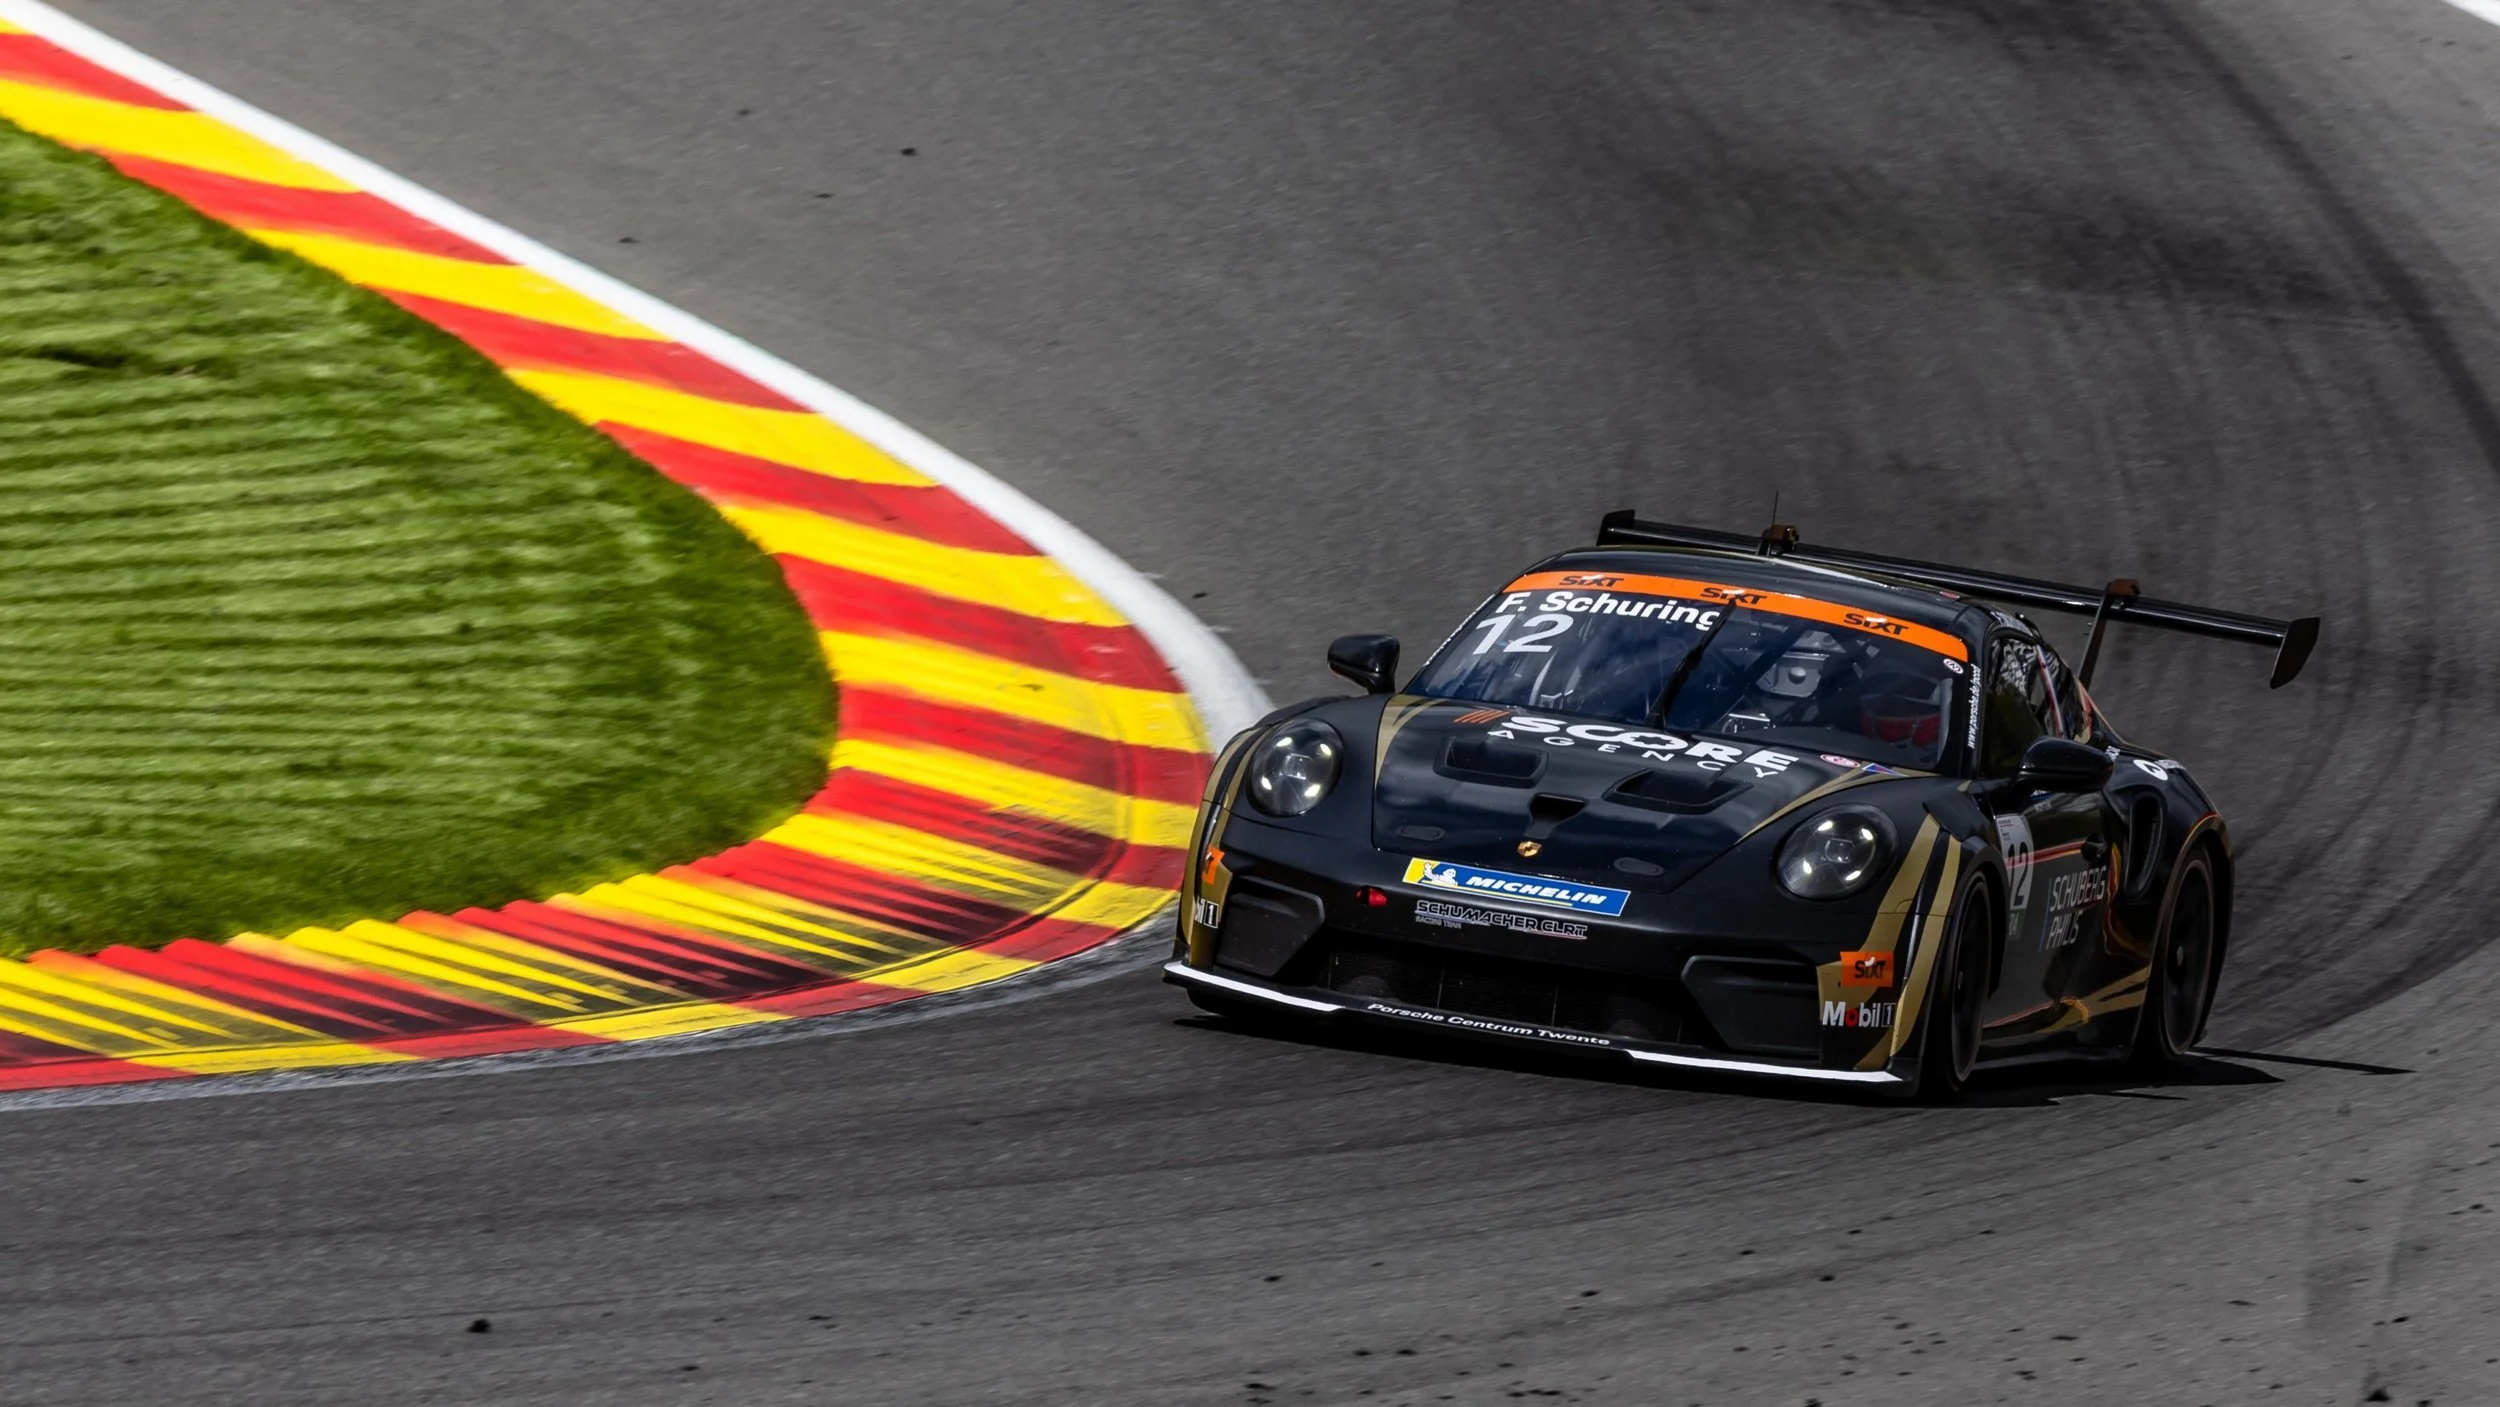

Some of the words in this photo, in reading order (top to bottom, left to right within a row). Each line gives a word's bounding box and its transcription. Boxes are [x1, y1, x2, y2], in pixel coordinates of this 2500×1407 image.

[1496, 592, 1531, 614] F.
[1539, 592, 1720, 631] Schuring
[1472, 613, 1574, 655] 12
[1487, 730, 1778, 779] AGENCY
[1501, 716, 1799, 771] SCORE
[1466, 876, 1607, 904] MICHELIN
[2049, 865, 2107, 912] SCHUBERG
[1416, 899, 1538, 930] SCHUMACHER
[1542, 919, 1588, 937] CLRT
[1367, 1003, 1444, 1021] Porsche
[1448, 1016, 1533, 1036] Centrum
[1538, 1029, 1611, 1046] Twente
[1822, 1000, 1881, 1027] Mobil
